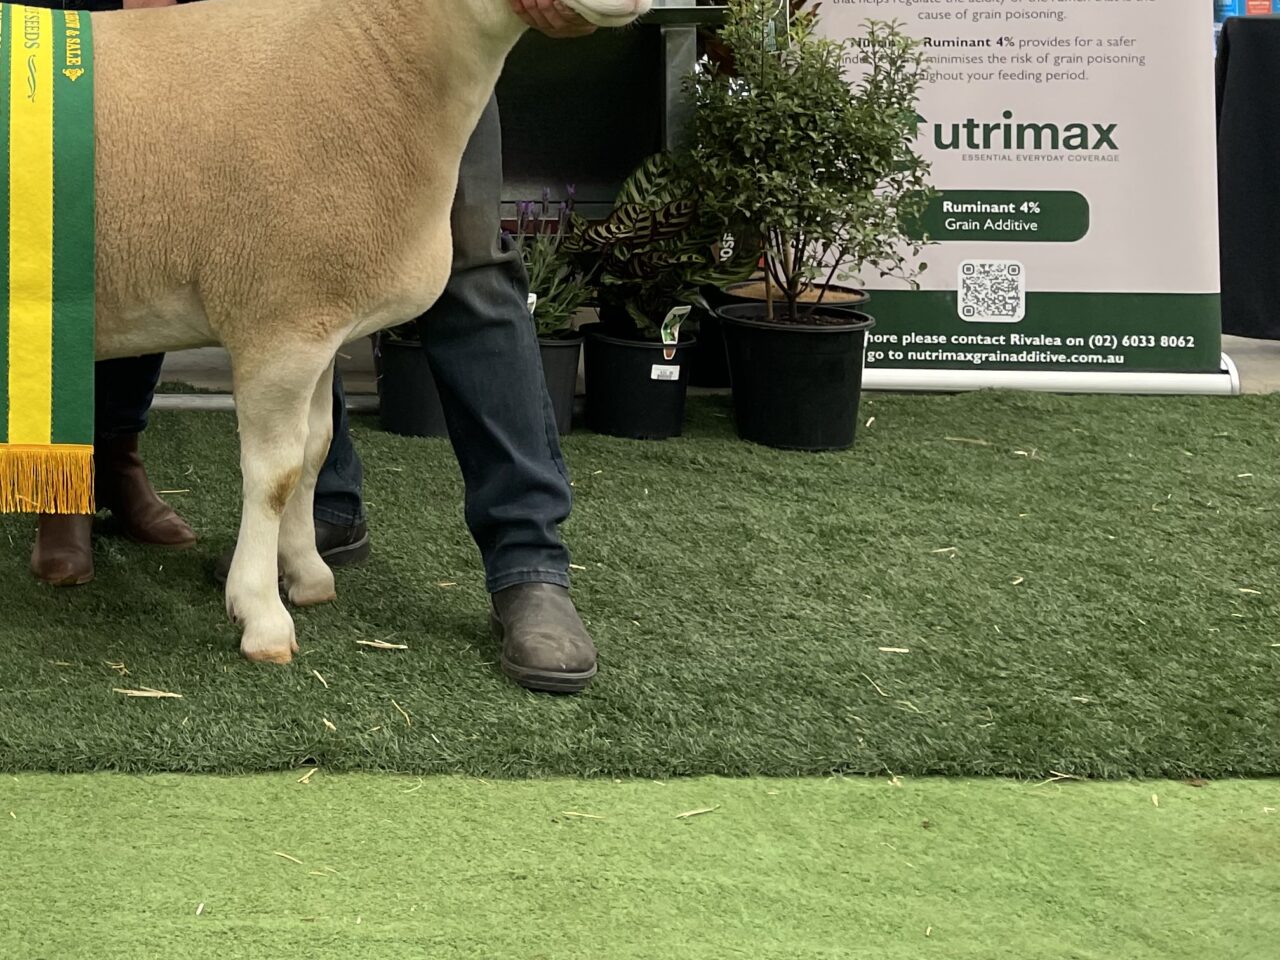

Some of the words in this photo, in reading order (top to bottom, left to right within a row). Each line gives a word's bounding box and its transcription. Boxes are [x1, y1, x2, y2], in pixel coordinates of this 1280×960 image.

[917, 11, 951, 20] cause
[955, 9, 969, 20] of
[972, 9, 1002, 22] grain
[1005, 9, 1067, 22] poisoning.
[24, 15, 40, 49] SEEDS
[923, 36, 991, 48] Ruminant
[996, 36, 1015, 47] 4%
[1019, 36, 1071, 49] provides
[1074, 36, 1093, 47] for
[1096, 39, 1103, 47] a
[1106, 36, 1137, 47] safer
[66, 37, 81, 66] SALE
[926, 53, 984, 64] minimises
[987, 53, 1007, 64] the
[1010, 53, 1033, 64] risk
[1036, 52, 1049, 64] of
[1053, 53, 1083, 66] grain
[1087, 53, 1146, 66] poisoning
[967, 72, 993, 82] your
[998, 70, 1042, 83] feeding
[1046, 70, 1089, 82] period.
[934, 110, 1119, 150] utrimax
[1016, 154, 1064, 162] EVERYDAY
[1067, 154, 1120, 162] COVERAGE
[943, 201, 1015, 213] Ruminant
[1019, 201, 1041, 214] 4%
[945, 218, 980, 230] Grain
[983, 218, 1038, 231] Additive
[902, 332, 947, 346] please
[951, 334, 1006, 345] contact
[1010, 333, 1062, 346] Rivalea
[1066, 336, 1084, 346] on
[1088, 334, 1118, 349] (02)
[1122, 335, 1155, 347] 6033
[1160, 335, 1195, 348] 8062
[867, 351, 884, 362] go
[888, 350, 904, 360] to
[908, 349, 1125, 364] nutrimaxgrainadditive.com.au
